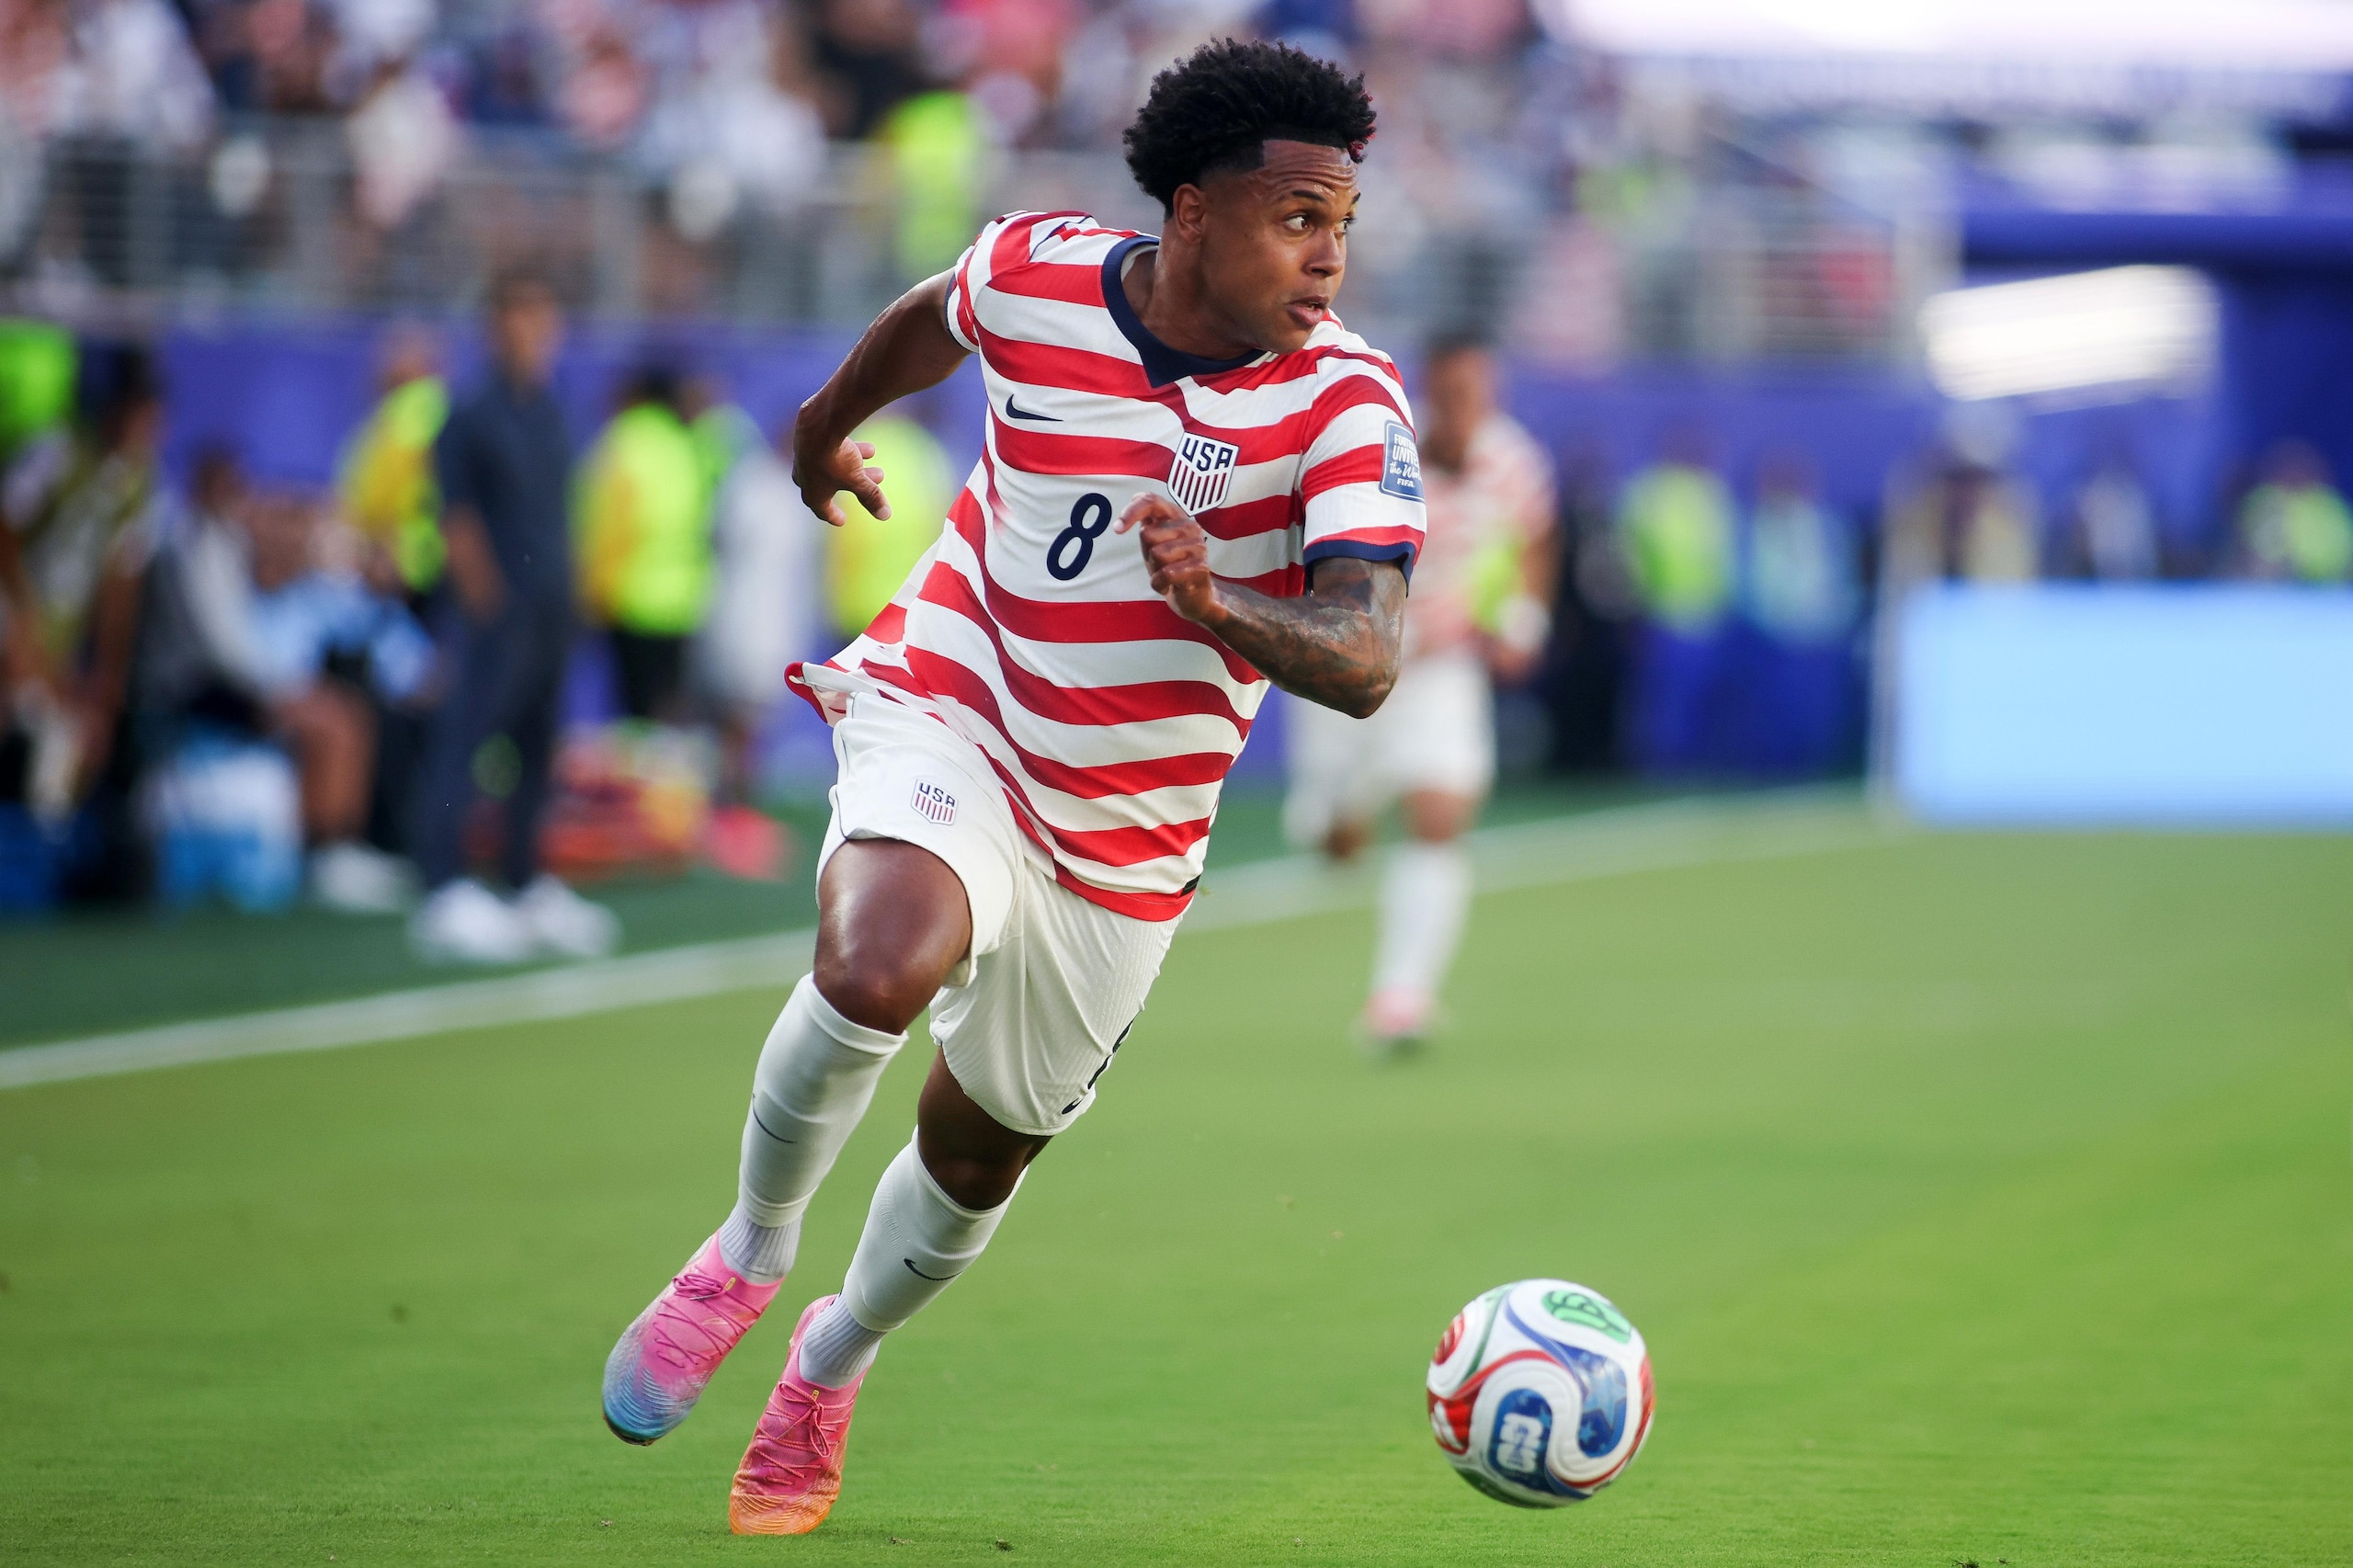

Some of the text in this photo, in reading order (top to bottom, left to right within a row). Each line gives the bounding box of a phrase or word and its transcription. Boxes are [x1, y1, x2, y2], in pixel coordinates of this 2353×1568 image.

[1182, 437, 1233, 472] USA
[1392, 445, 1420, 468] UNITE
[1389, 461, 1402, 475] the
[1396, 478, 1414, 488] FIFA
[1046, 493, 1112, 581] 8
[919, 782, 955, 807] USA
